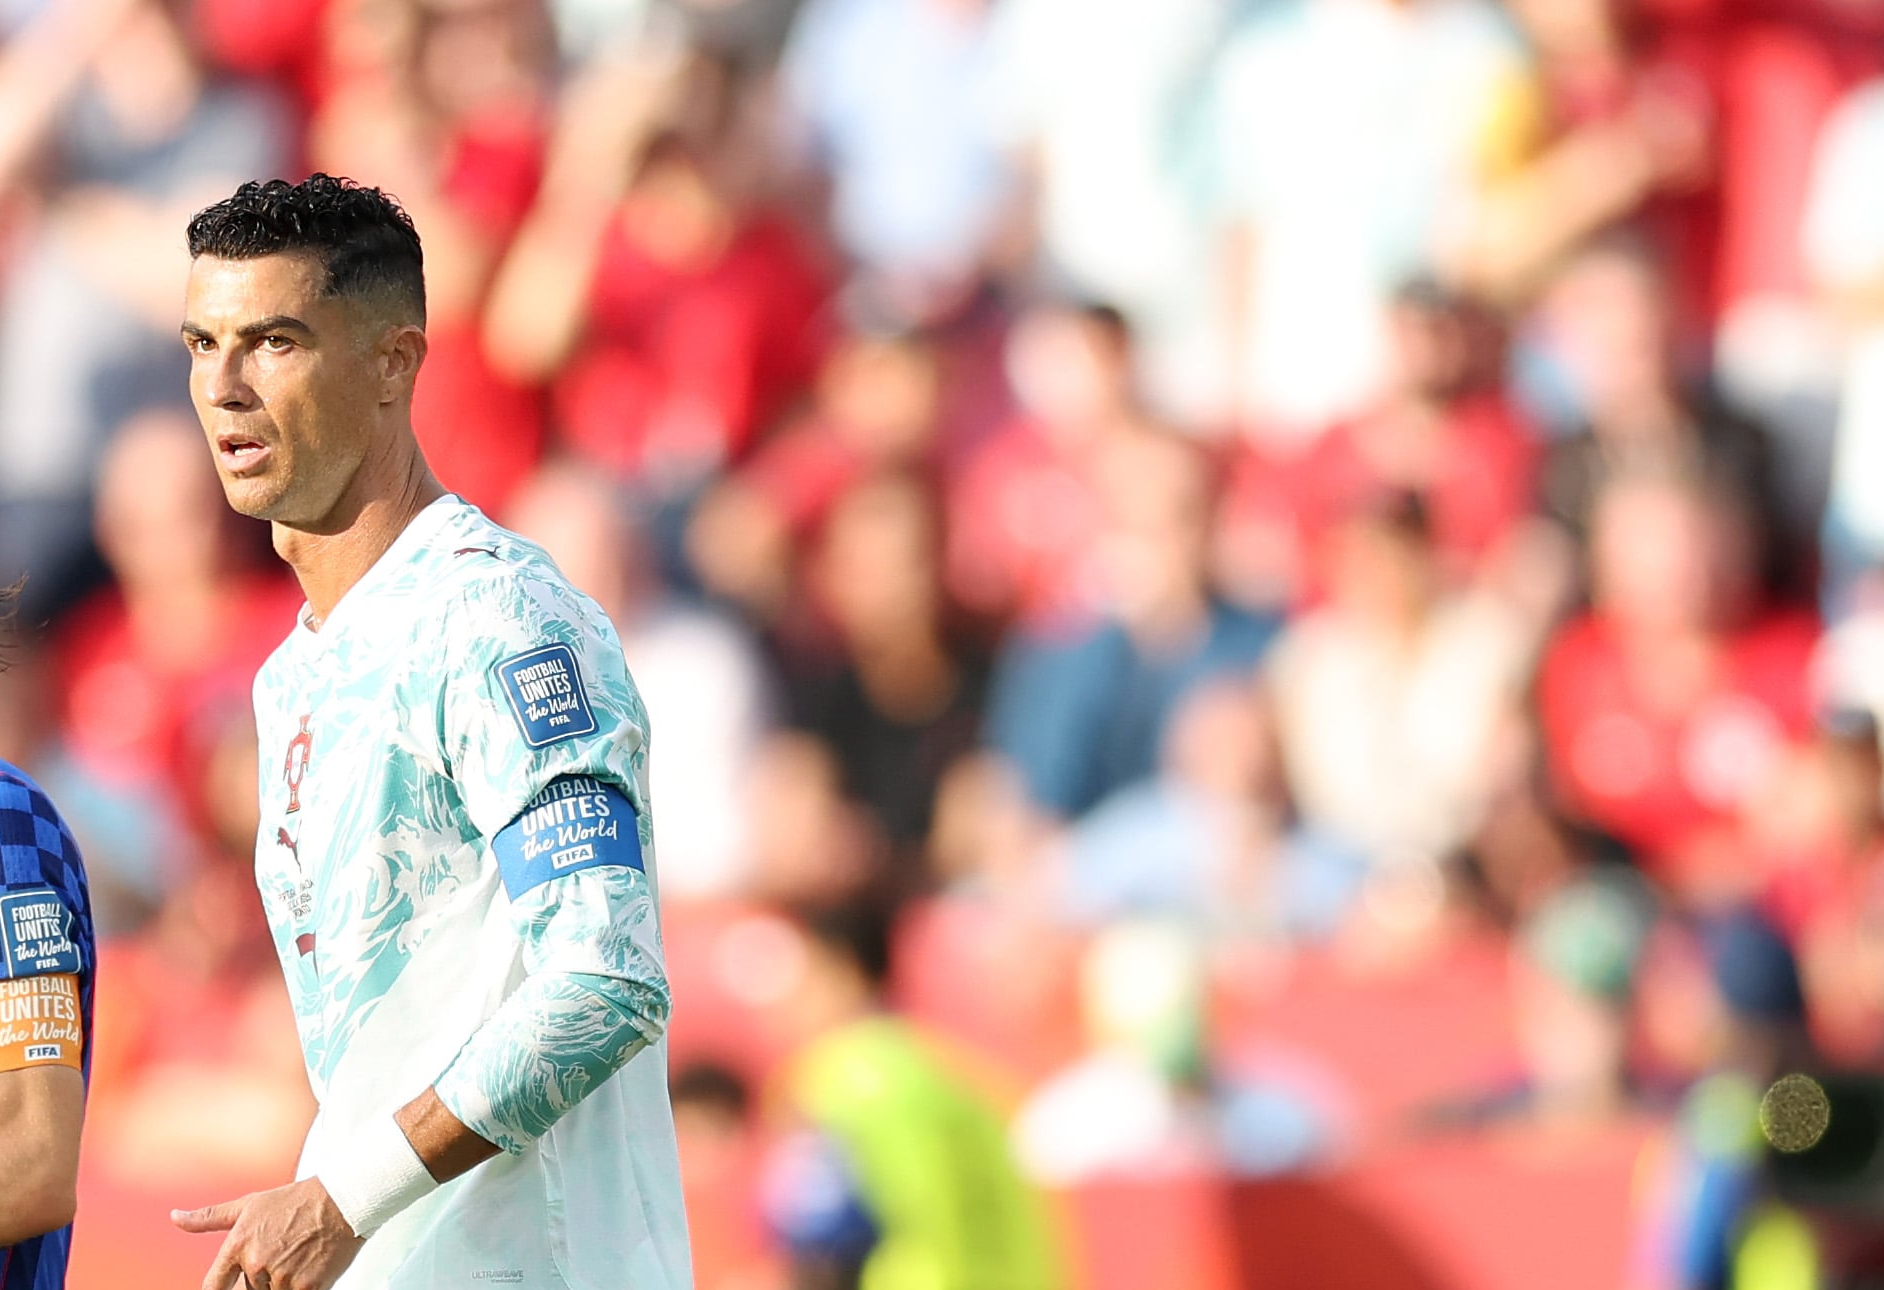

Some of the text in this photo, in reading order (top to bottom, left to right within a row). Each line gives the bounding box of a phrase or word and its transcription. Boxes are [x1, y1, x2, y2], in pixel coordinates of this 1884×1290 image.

[513, 658, 567, 686] FOOTBALL
[519, 673, 572, 704] UNITES
[525, 692, 580, 722] the World
[549, 714, 571, 727] FIFA
[521, 794, 611, 836] UNITES
[520, 818, 618, 861] the World
[556, 847, 591, 865] FIFA
[12, 903, 61, 921] FOOTBALL
[14, 936, 72, 961] the World
[36, 958, 60, 970] FIFA
[0, 995, 75, 1023] UNITES
[32, 1021, 79, 1047] World
[28, 1046, 58, 1058] FIFA
